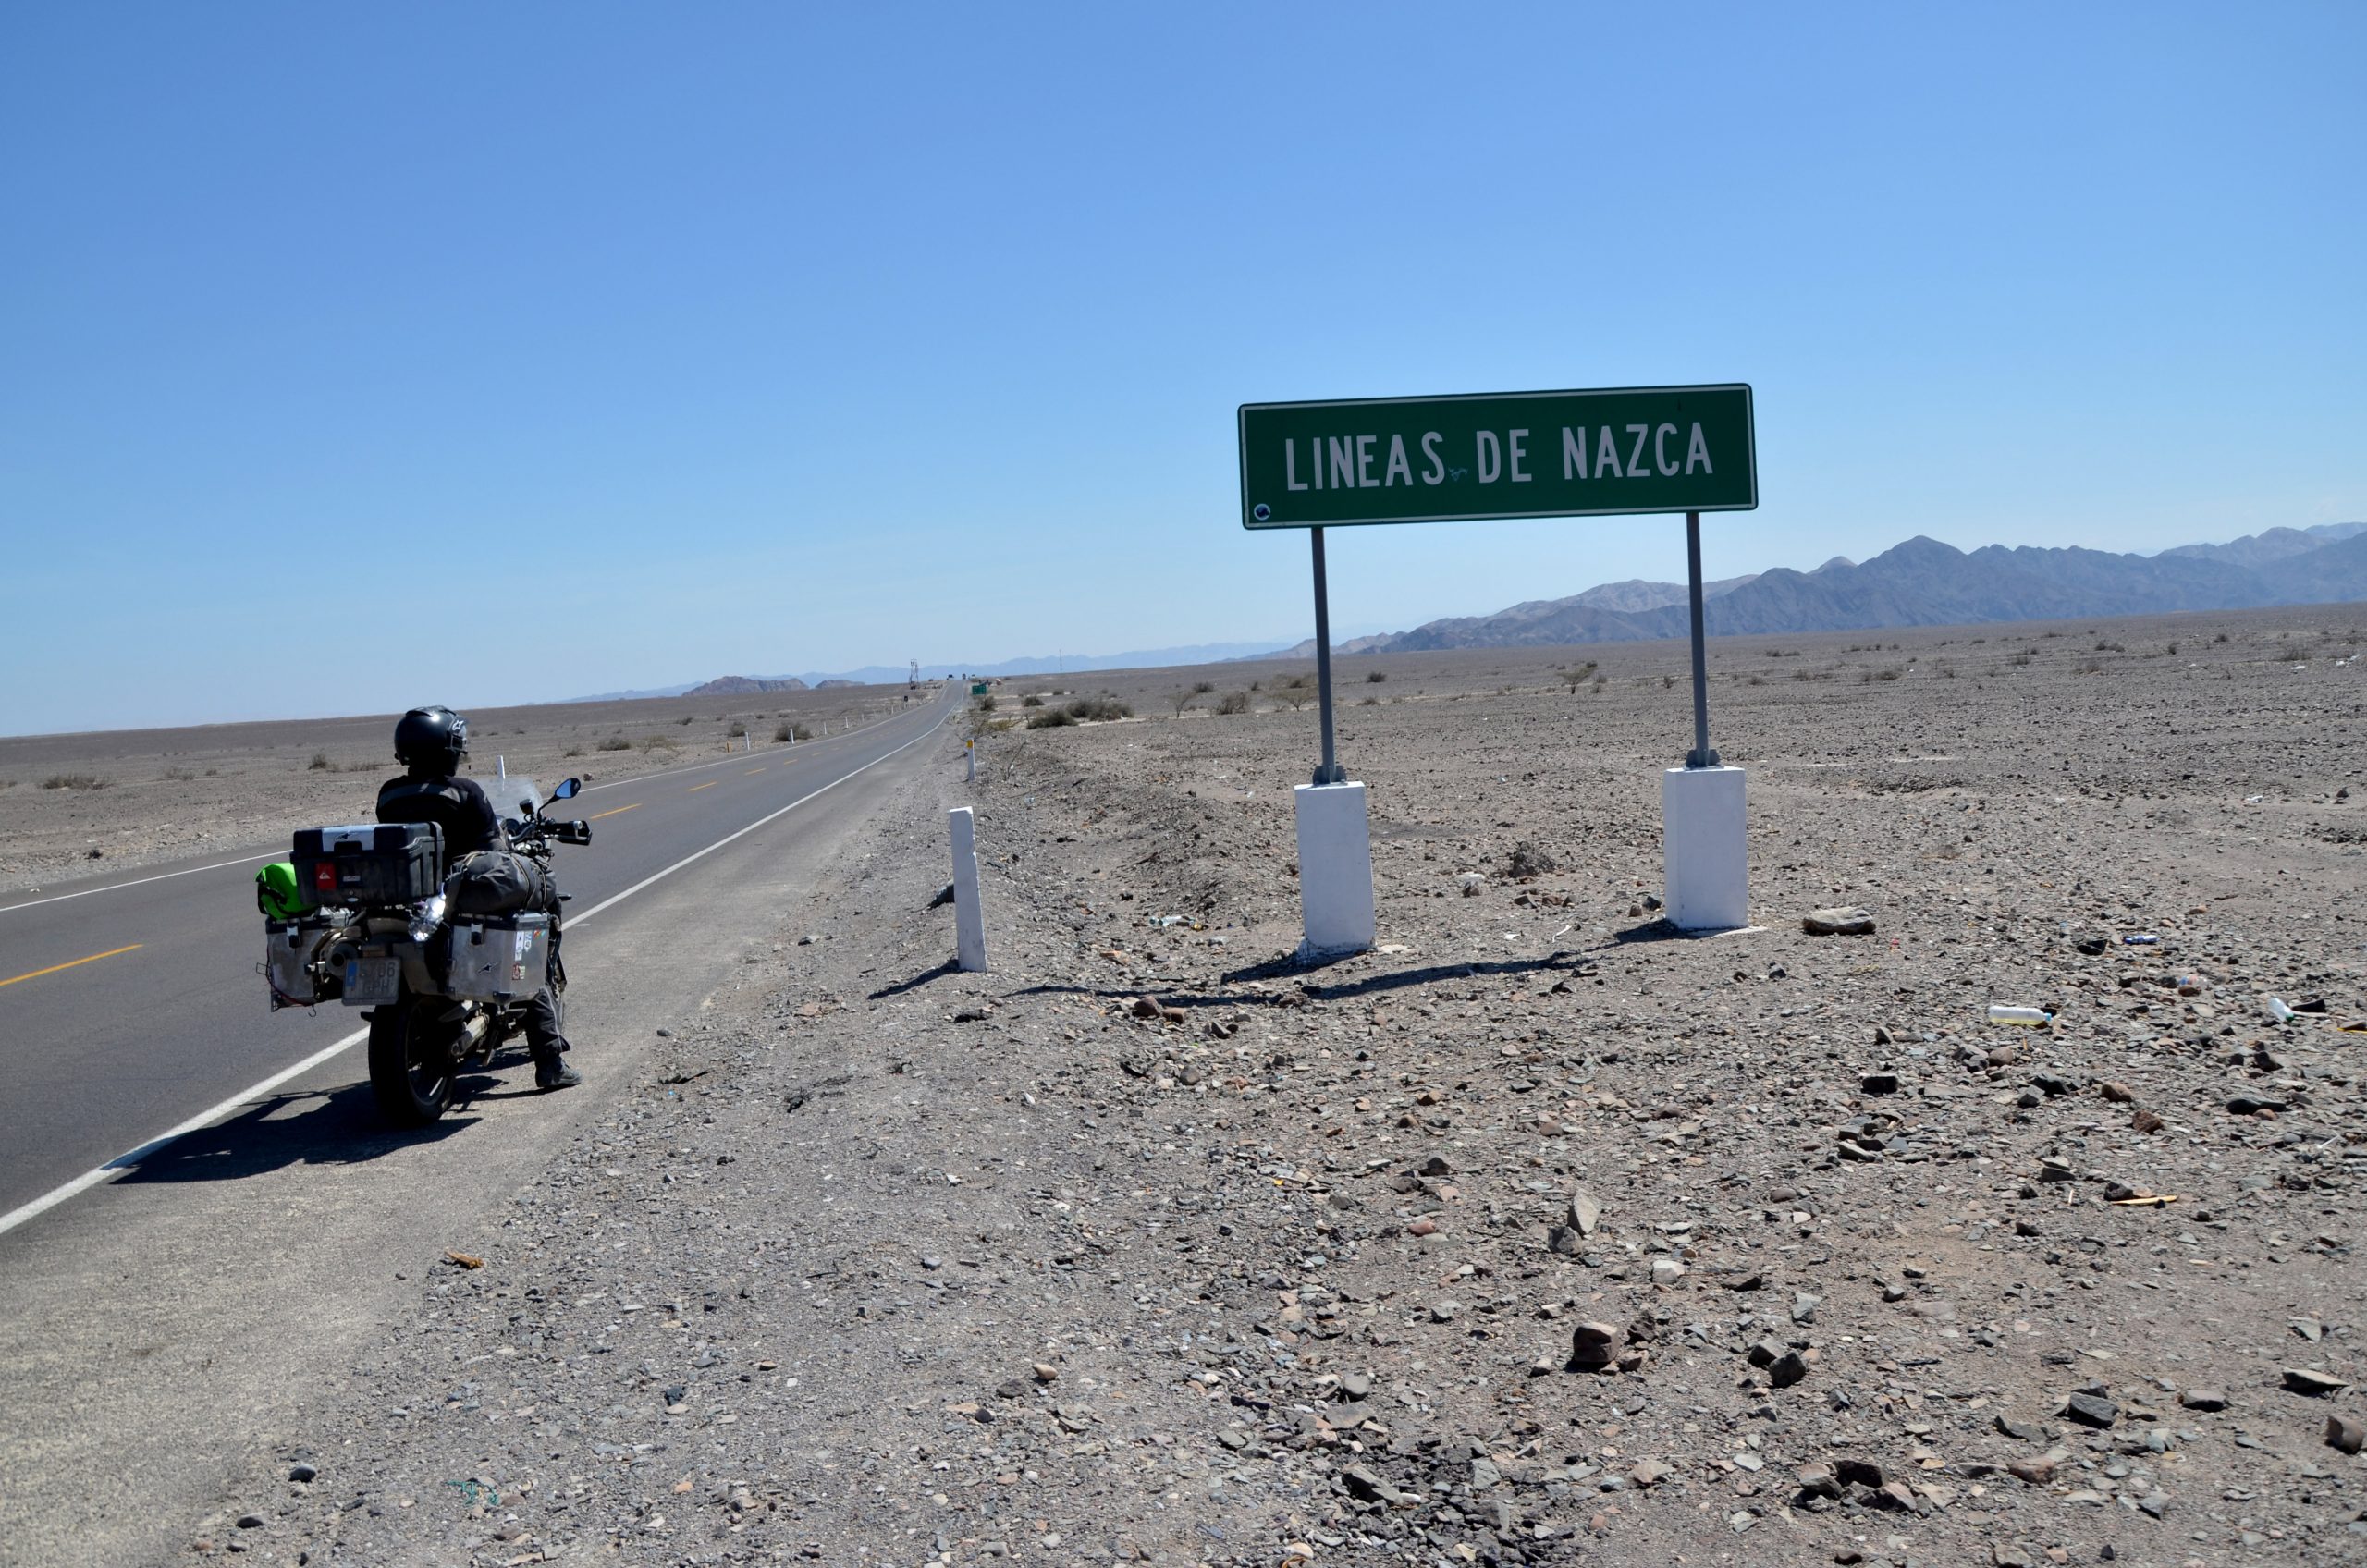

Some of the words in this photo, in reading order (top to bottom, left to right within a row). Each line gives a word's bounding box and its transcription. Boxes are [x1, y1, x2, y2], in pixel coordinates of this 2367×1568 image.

[1285, 431, 1445, 491] LINEAS
[1477, 429, 1532, 484] DE
[1562, 422, 1713, 480] NAZCA
